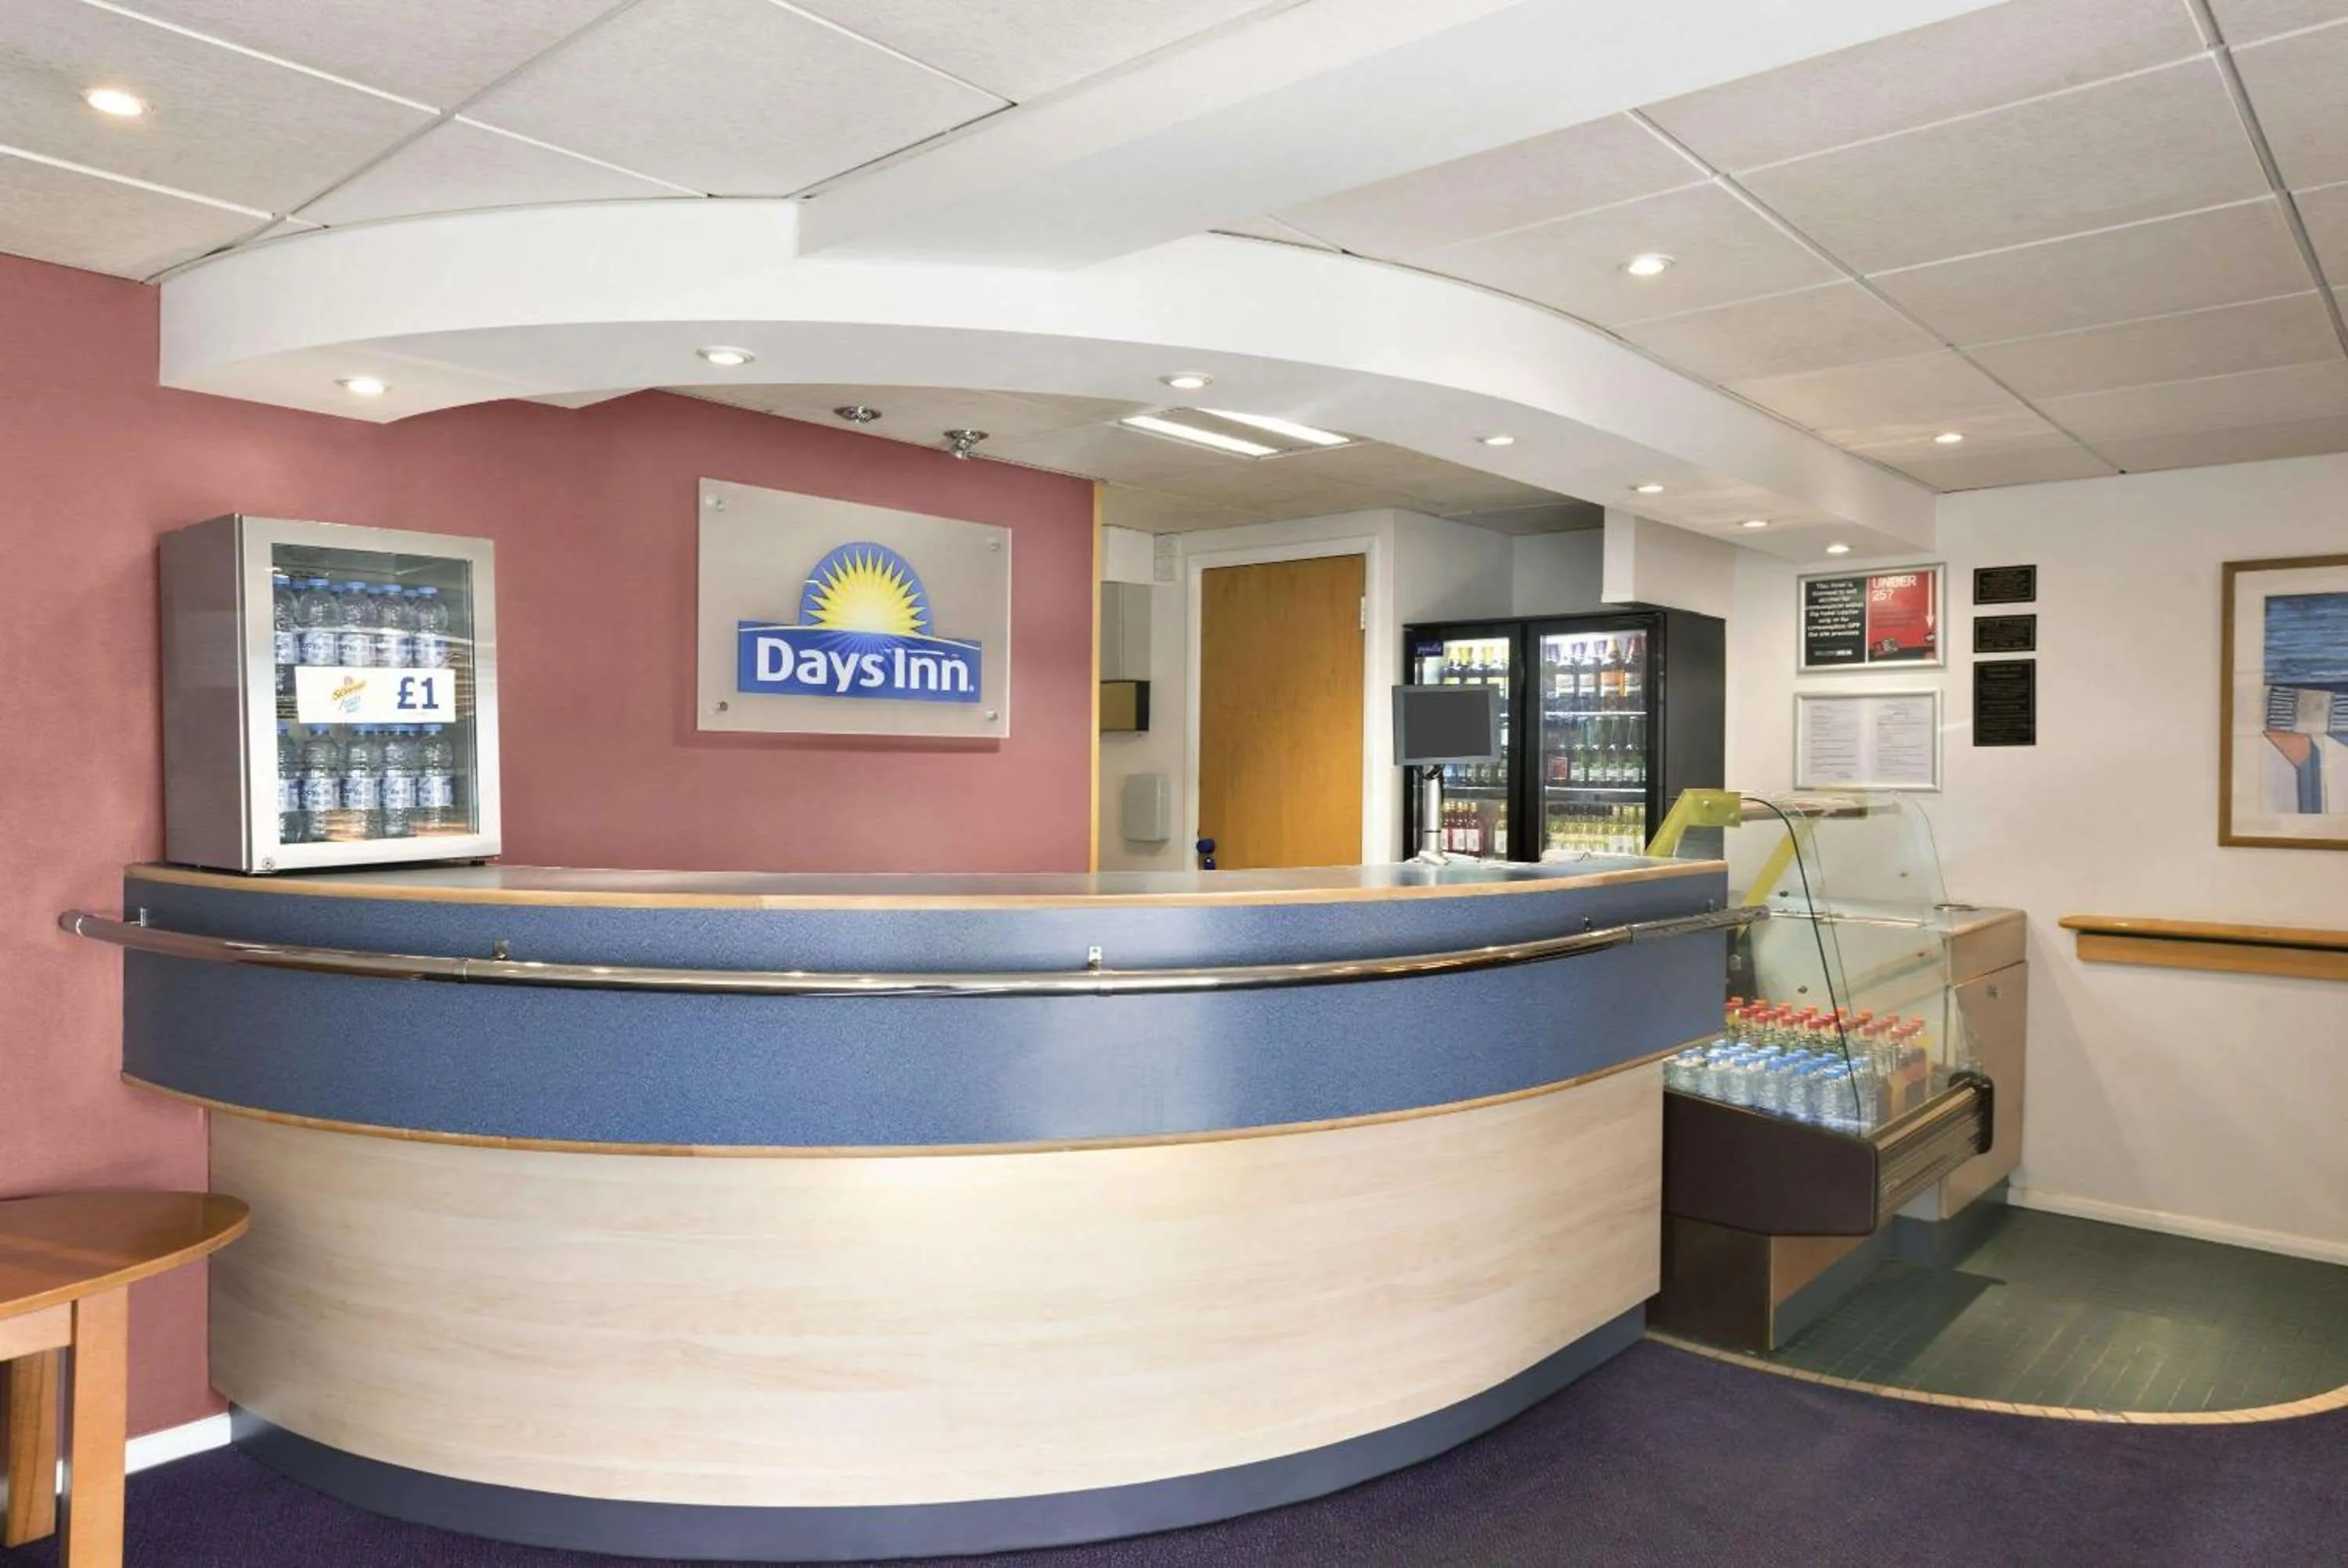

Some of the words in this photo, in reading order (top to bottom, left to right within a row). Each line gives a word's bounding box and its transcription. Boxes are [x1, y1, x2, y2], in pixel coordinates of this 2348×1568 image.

[1871, 588, 1894, 602] 25?
[756, 636, 885, 692] Days
[894, 647, 970, 692] Inn
[397, 675, 439, 710] £1
